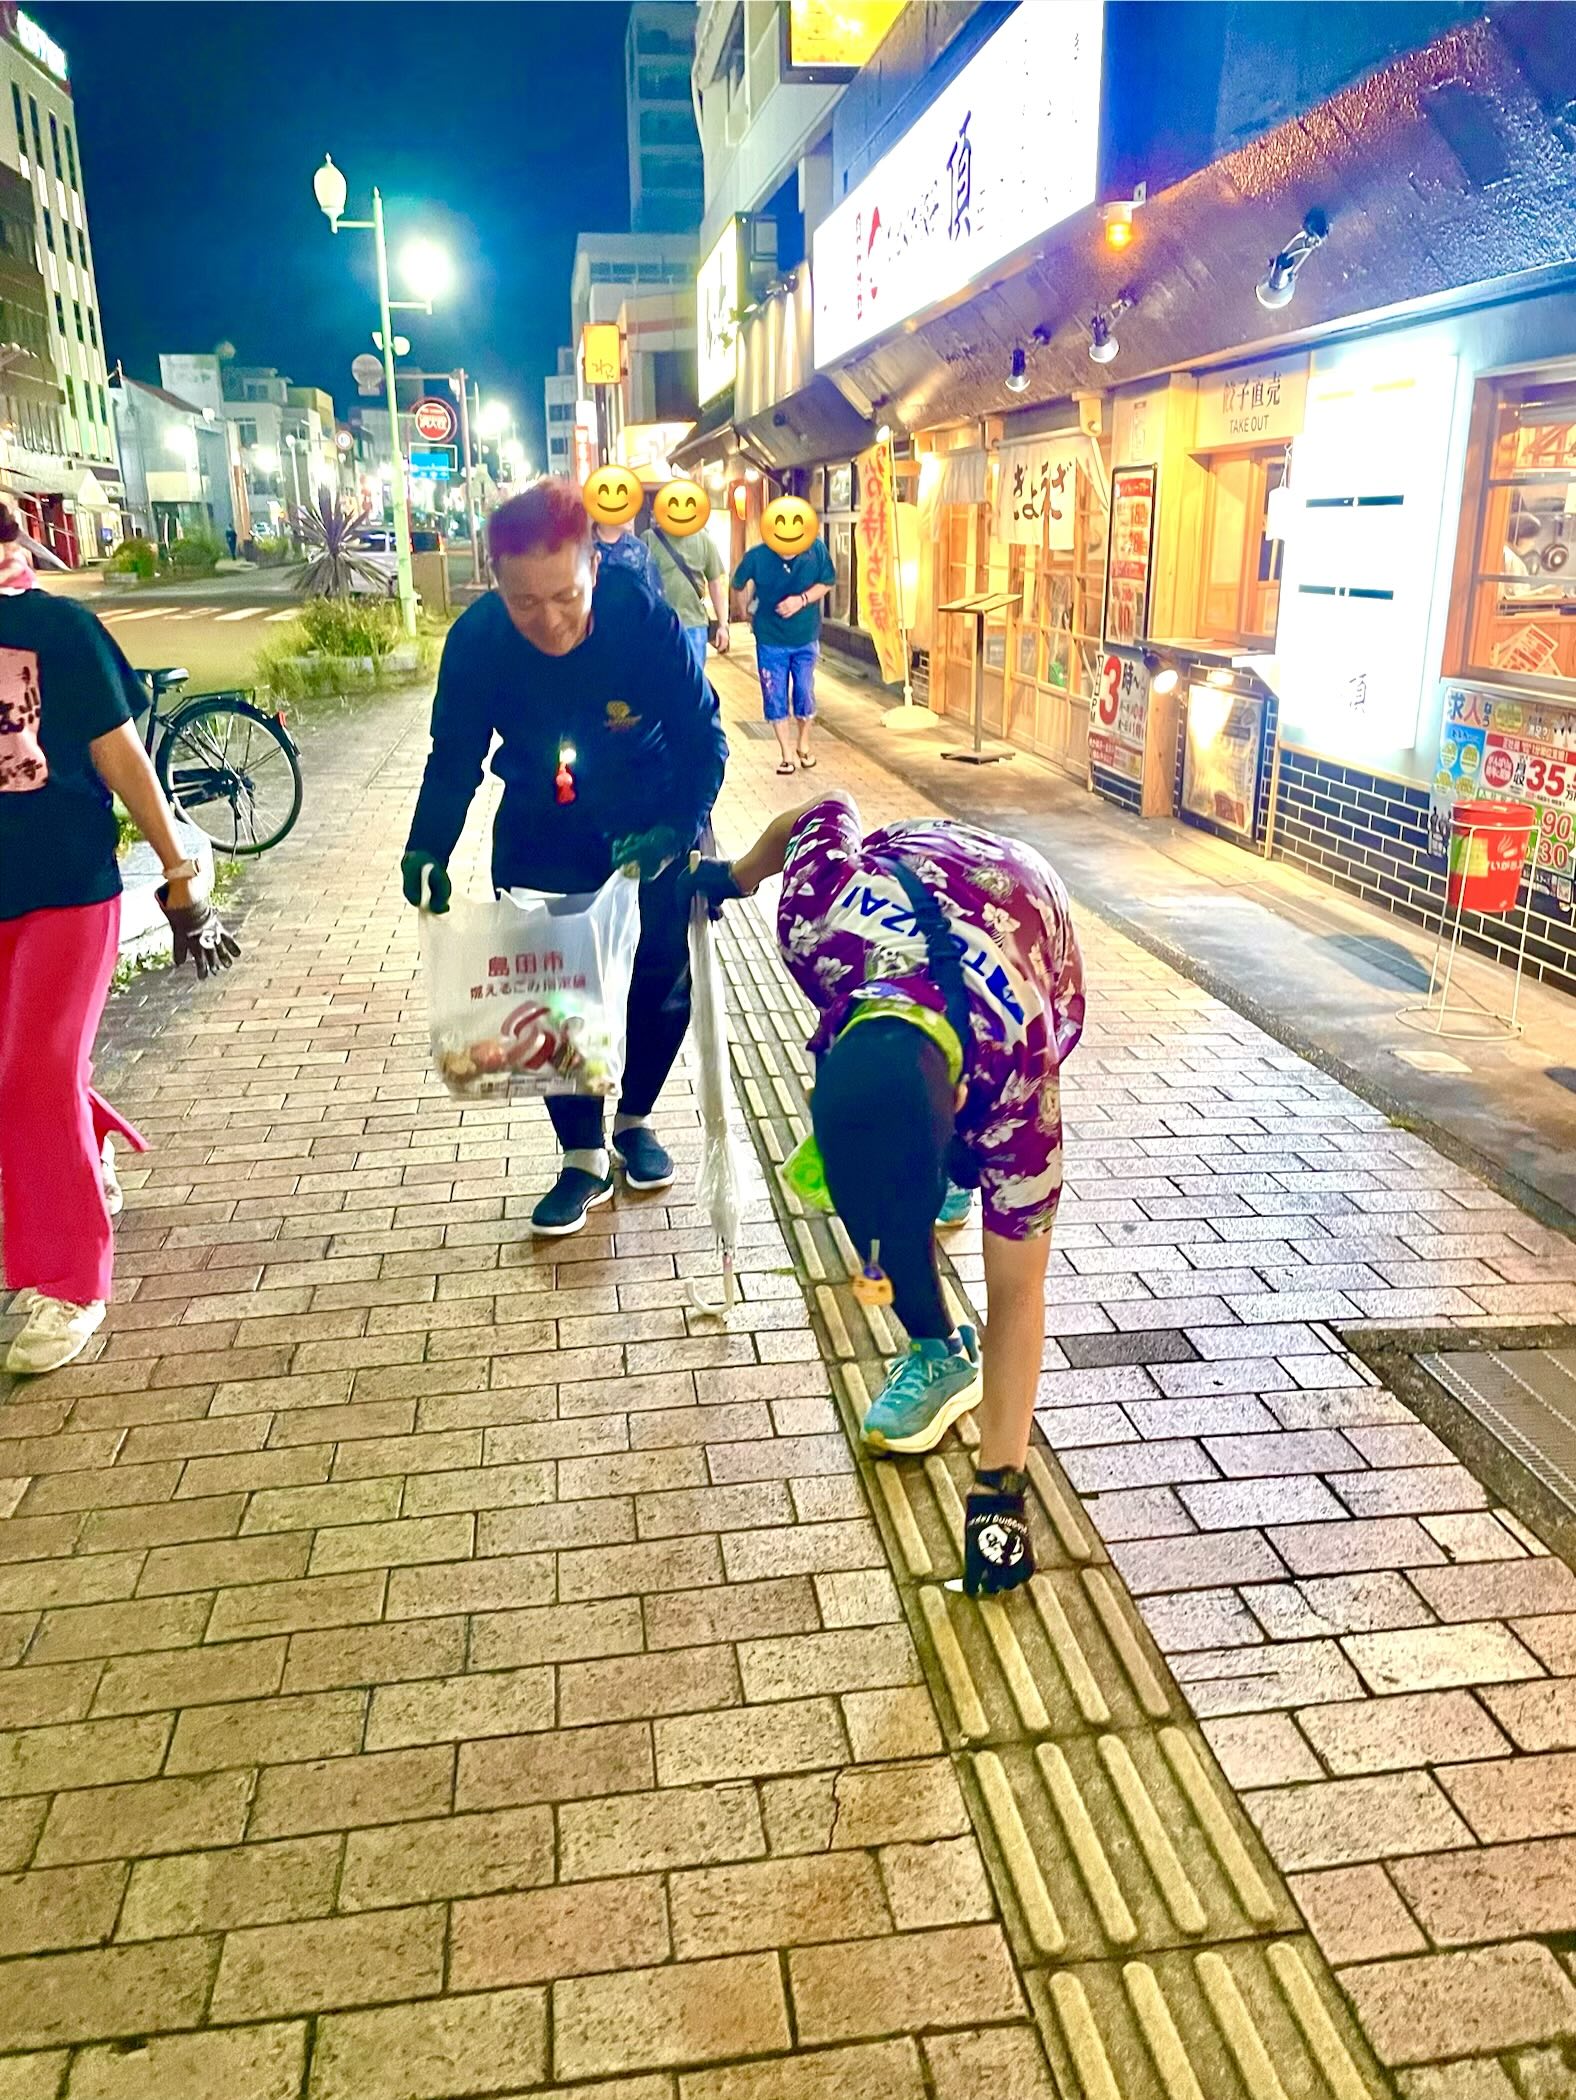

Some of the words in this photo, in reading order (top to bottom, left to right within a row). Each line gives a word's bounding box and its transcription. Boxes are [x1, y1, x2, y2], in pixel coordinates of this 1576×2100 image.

[1223, 370, 1282, 414] 餃子直売
[1230, 418, 1249, 433] TAKE
[1251, 415, 1269, 432] OUT
[1447, 691, 1481, 725] 求人
[487, 951, 563, 977] 島田市
